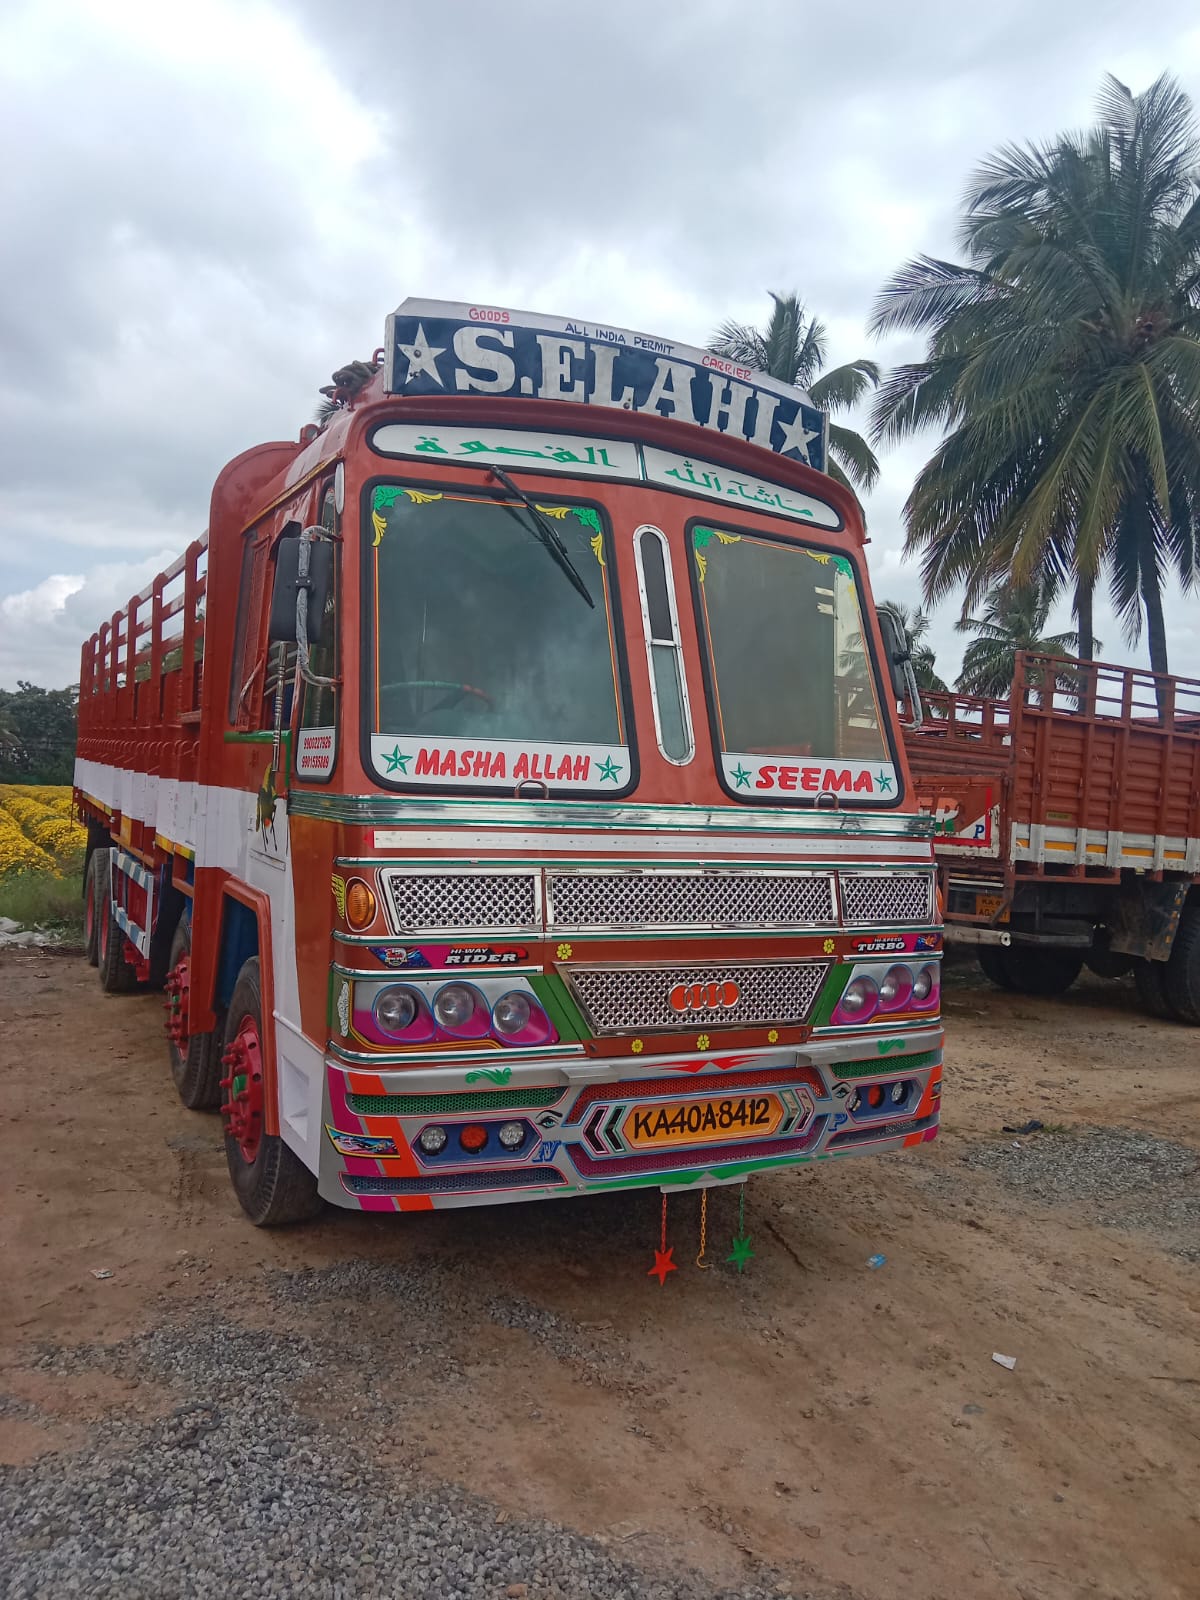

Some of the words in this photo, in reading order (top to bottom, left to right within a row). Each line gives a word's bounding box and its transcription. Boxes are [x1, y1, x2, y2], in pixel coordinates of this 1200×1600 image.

[469, 308, 510, 323] GOODS
[565, 322, 590, 337] ALL
[596, 328, 626, 345] INDIA
[634, 336, 675, 356] PERMIT
[702, 355, 752, 381] CARRIER
[453, 326, 780, 450] S.ELAHI
[415, 748, 506, 778] MASHA
[513, 753, 591, 782] ALLAH
[756, 765, 873, 792] SEEMA
[973, 824, 985, 839] P
[445, 953, 517, 964] RIDER
[857, 941, 905, 951] TURBO
